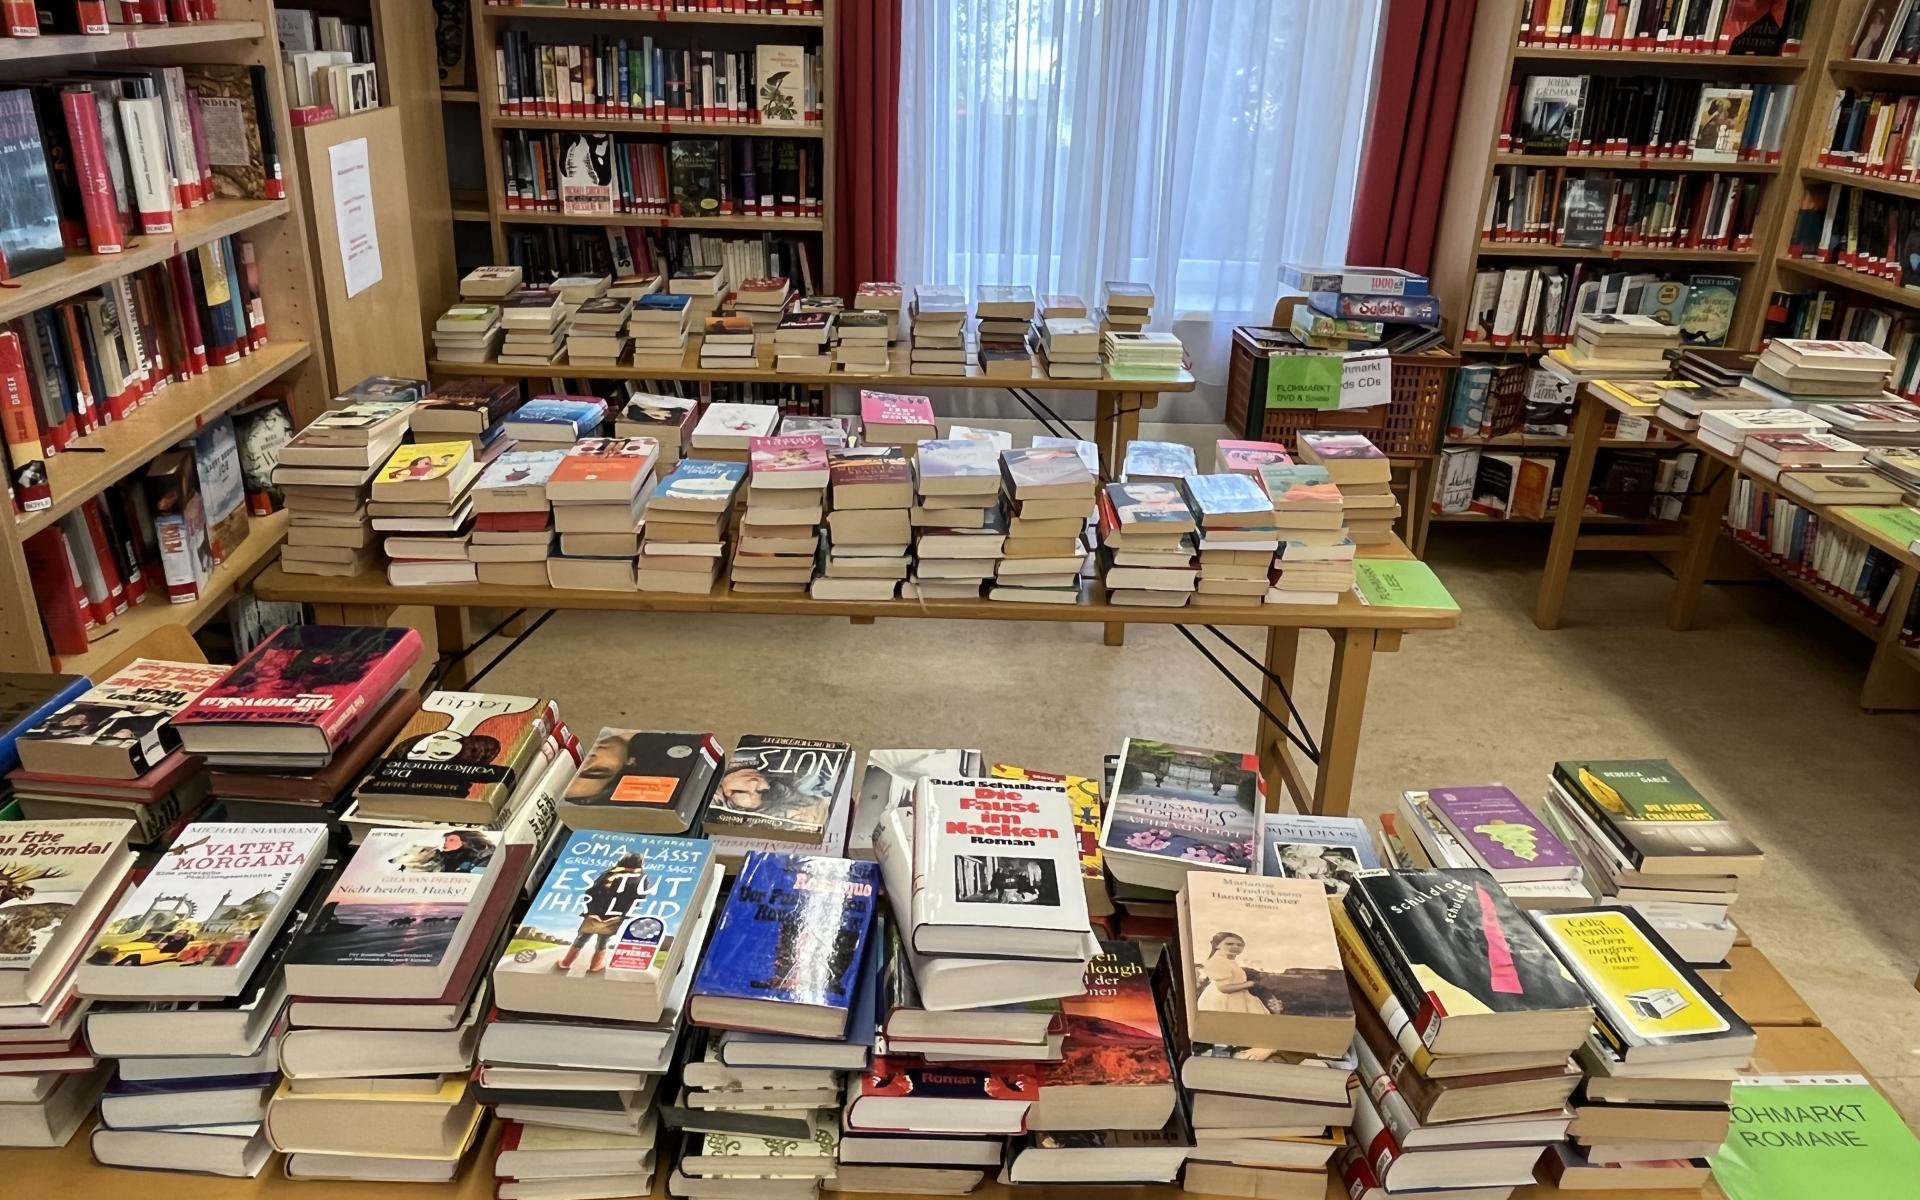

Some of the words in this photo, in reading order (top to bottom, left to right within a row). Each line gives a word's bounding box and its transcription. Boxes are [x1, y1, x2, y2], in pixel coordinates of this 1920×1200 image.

[1536, 87, 1577, 97] GRISHAM
[1371, 277, 1394, 289] 1000
[7, 376, 18, 392] SEX
[1276, 384, 1331, 392] FLOHMARKT
[1358, 377, 1381, 388] CDs
[1276, 394, 1296, 402] DVD
[106, 678, 173, 689] CAINE
[136, 688, 188, 700] Wouk
[106, 694, 189, 708] Herman
[436, 695, 514, 713] Lady
[386, 761, 496, 775] vollkommene
[757, 748, 843, 777] NUTS
[382, 768, 412, 779] Die
[979, 780, 1066, 793] Schulberg
[975, 788, 1023, 801] Die
[959, 798, 1040, 814] Faust
[1134, 797, 1238, 827] Schwestern
[1644, 804, 1664, 812] DIE
[1664, 803, 1704, 812] FARBEN
[748, 818, 783, 829] Claudia
[981, 811, 1022, 825] im
[190, 826, 248, 834] MICHAEL
[250, 827, 319, 835] NIAVARANI
[946, 821, 1059, 839] Nacken
[1169, 824, 1240, 839] LUCINDA
[18, 831, 64, 844] Erbe
[591, 833, 636, 843] FREDRIK
[641, 837, 694, 848] BACKMAN
[971, 836, 1036, 847] Roman
[20, 841, 113, 858] Björndal
[204, 841, 296, 856] VATER
[571, 842, 628, 859] OMA
[643, 847, 703, 863] LÄSST
[172, 852, 306, 871] MORGANA
[564, 857, 618, 868] GRÜSSEN
[642, 863, 665, 871] UND
[666, 864, 697, 874] SAGT
[551, 867, 598, 891] ES
[612, 873, 693, 898] TUT
[337, 885, 371, 895] Nicht
[422, 885, 467, 896] Husky!
[1212, 891, 1254, 902] Hannas
[1390, 878, 1463, 914] Schuldlos
[537, 892, 593, 914] IHR
[605, 897, 681, 920] LEID
[1444, 883, 1474, 924] schuldig
[1568, 918, 1606, 928] Celia
[1565, 926, 1624, 938] Fremlin
[1582, 936, 1627, 946] Sieben
[615, 949, 652, 959] SPIEGEL
[1588, 946, 1635, 956] magere
[1602, 954, 1639, 965] Jahre
[1095, 976, 1120, 986] der
[922, 1072, 977, 1086] Roman
[1729, 1104, 1867, 1124] OHMARKT
[1739, 1131, 1869, 1148] ROMANE
